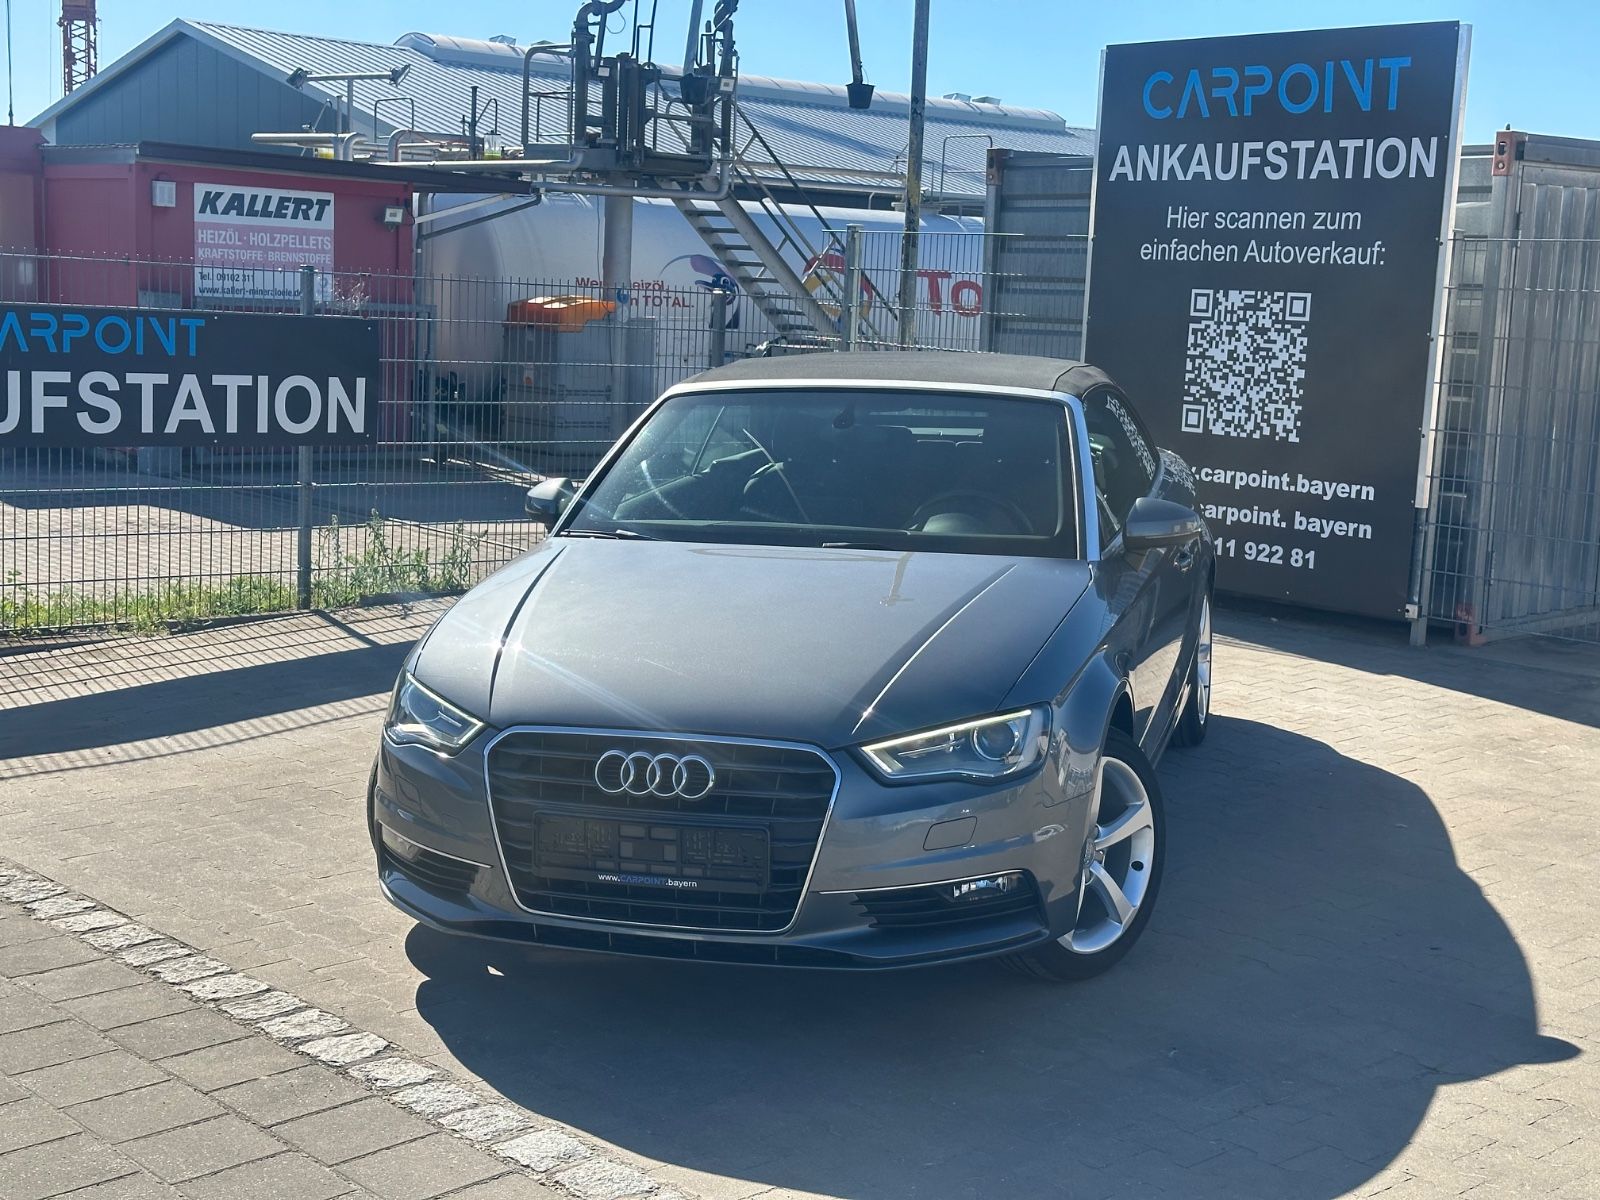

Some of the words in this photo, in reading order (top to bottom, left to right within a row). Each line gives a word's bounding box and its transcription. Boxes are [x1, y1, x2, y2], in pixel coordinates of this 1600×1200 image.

[1142, 56, 1412, 119] CARPOINT
[1108, 136, 1438, 182] ANKAUFSTATION
[198, 190, 332, 222] KALLERT
[1166, 206, 1209, 229] Hier
[1214, 209, 1306, 230] scannen
[1312, 211, 1362, 230] zum
[198, 228, 242, 245] HEIZÖL
[250, 232, 331, 250] HOLZPELLETS
[1140, 238, 1238, 262] einfachen
[1244, 239, 1386, 265] Autoverkauf:
[198, 248, 263, 261] KRAFTSTOFFE
[268, 251, 331, 264] BRENNSTOFFE
[642, 295, 694, 308] TOTAL.
[916, 269, 983, 317] To
[0, 311, 206, 357] ARPOINT
[1192, 466, 1375, 501] .carpoint.bayern
[1200, 502, 1286, 528] arpoint.
[1294, 511, 1372, 539] bayern
[1244, 541, 1284, 565] 922
[1290, 548, 1316, 570] 81
[598, 873, 697, 888] www.CARPOINT.bayern
